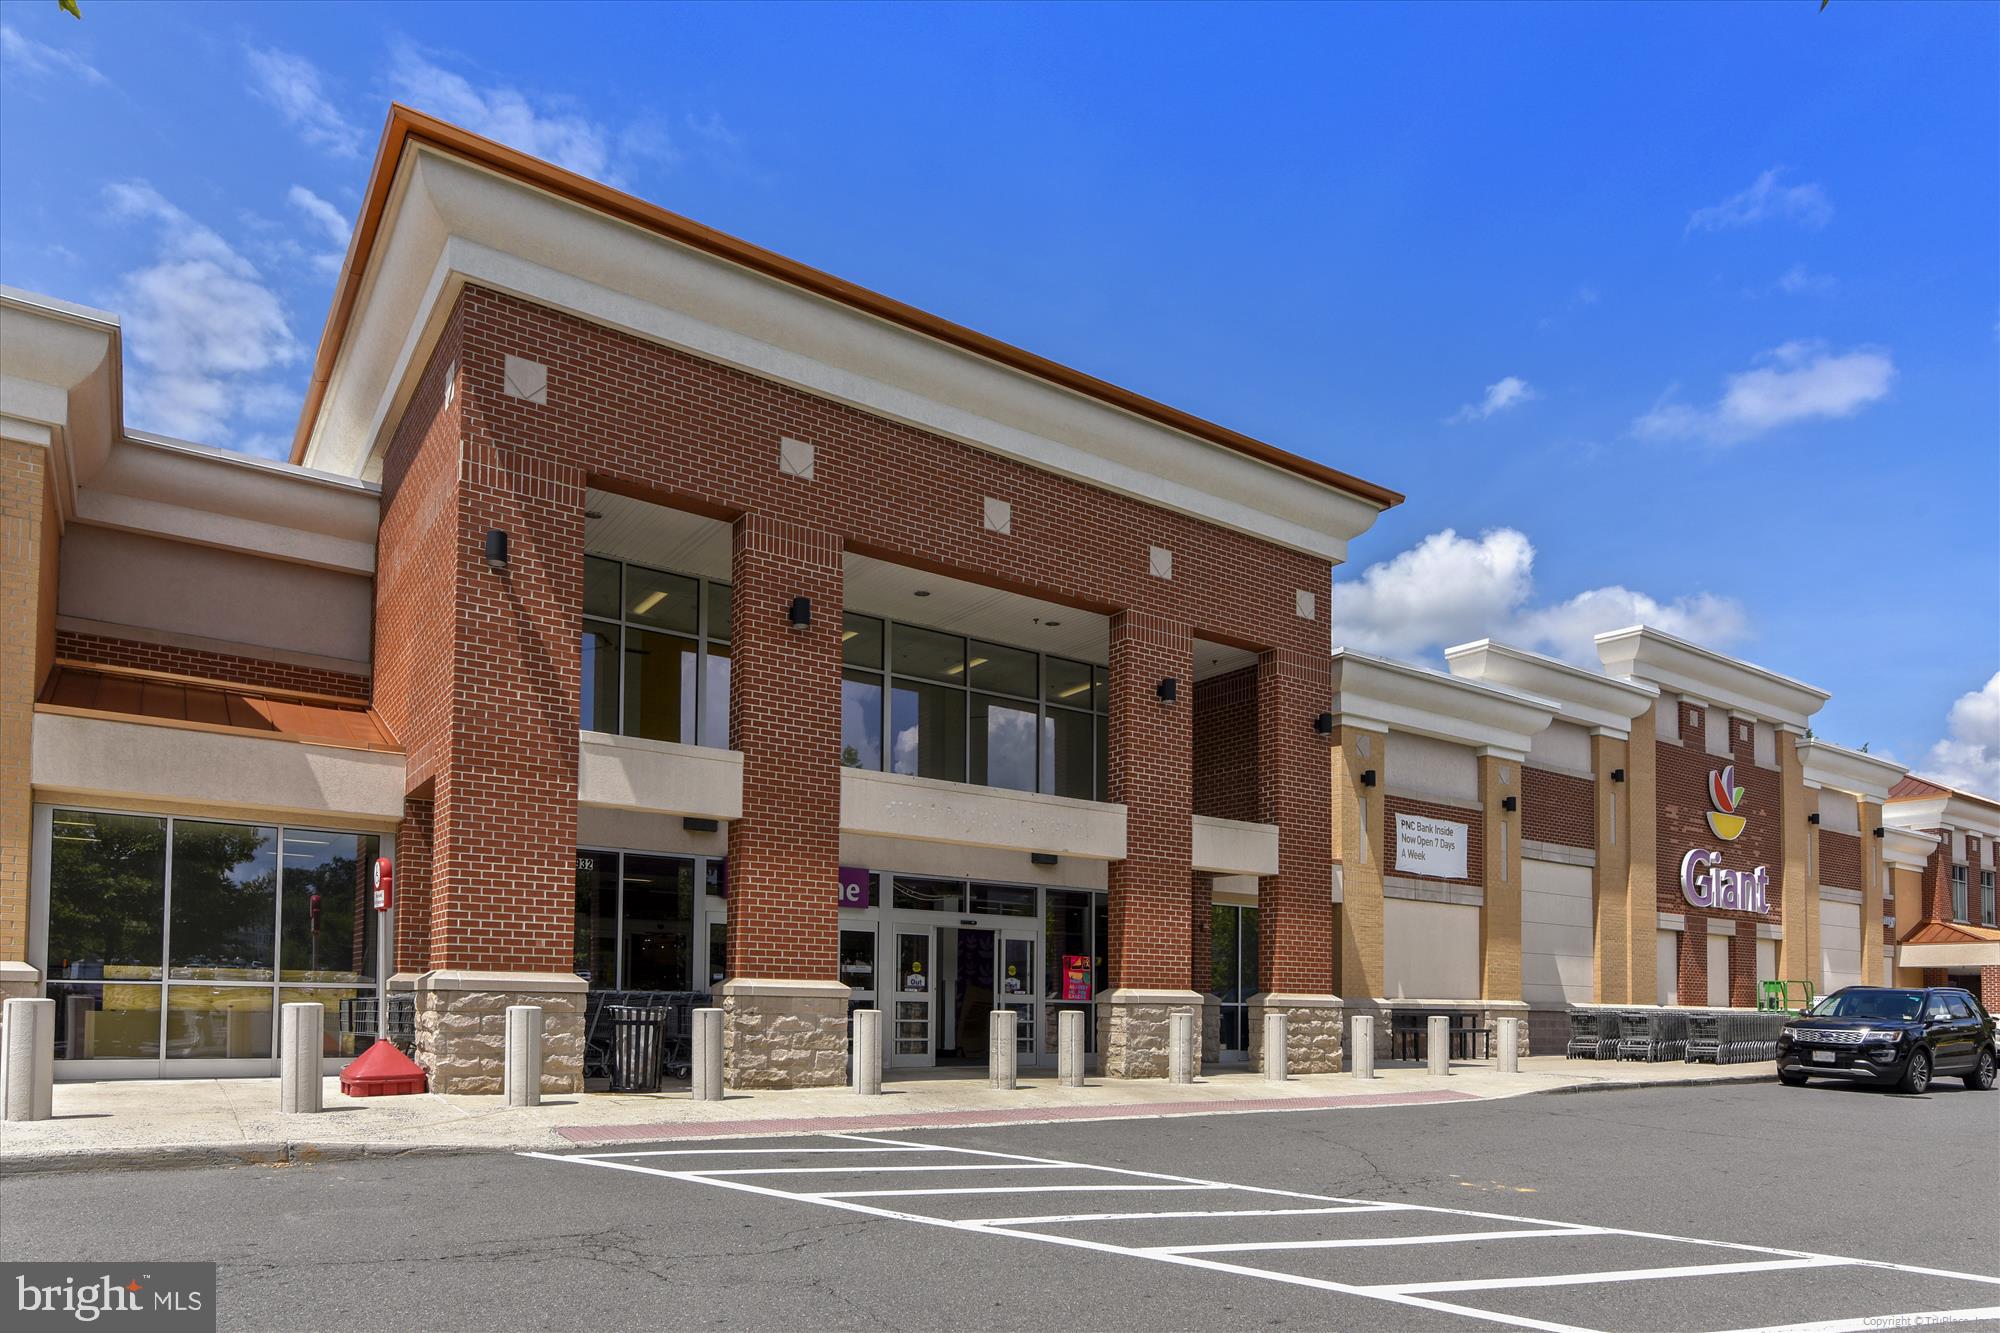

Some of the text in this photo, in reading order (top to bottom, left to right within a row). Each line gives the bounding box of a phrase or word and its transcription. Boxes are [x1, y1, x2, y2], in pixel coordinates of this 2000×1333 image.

[1401, 820, 1454, 836] PNC Bank Inside
[1402, 833, 1455, 851] Now Open 7 Days
[1402, 849, 1426, 861] A Week
[1680, 848, 1771, 914] Giant
